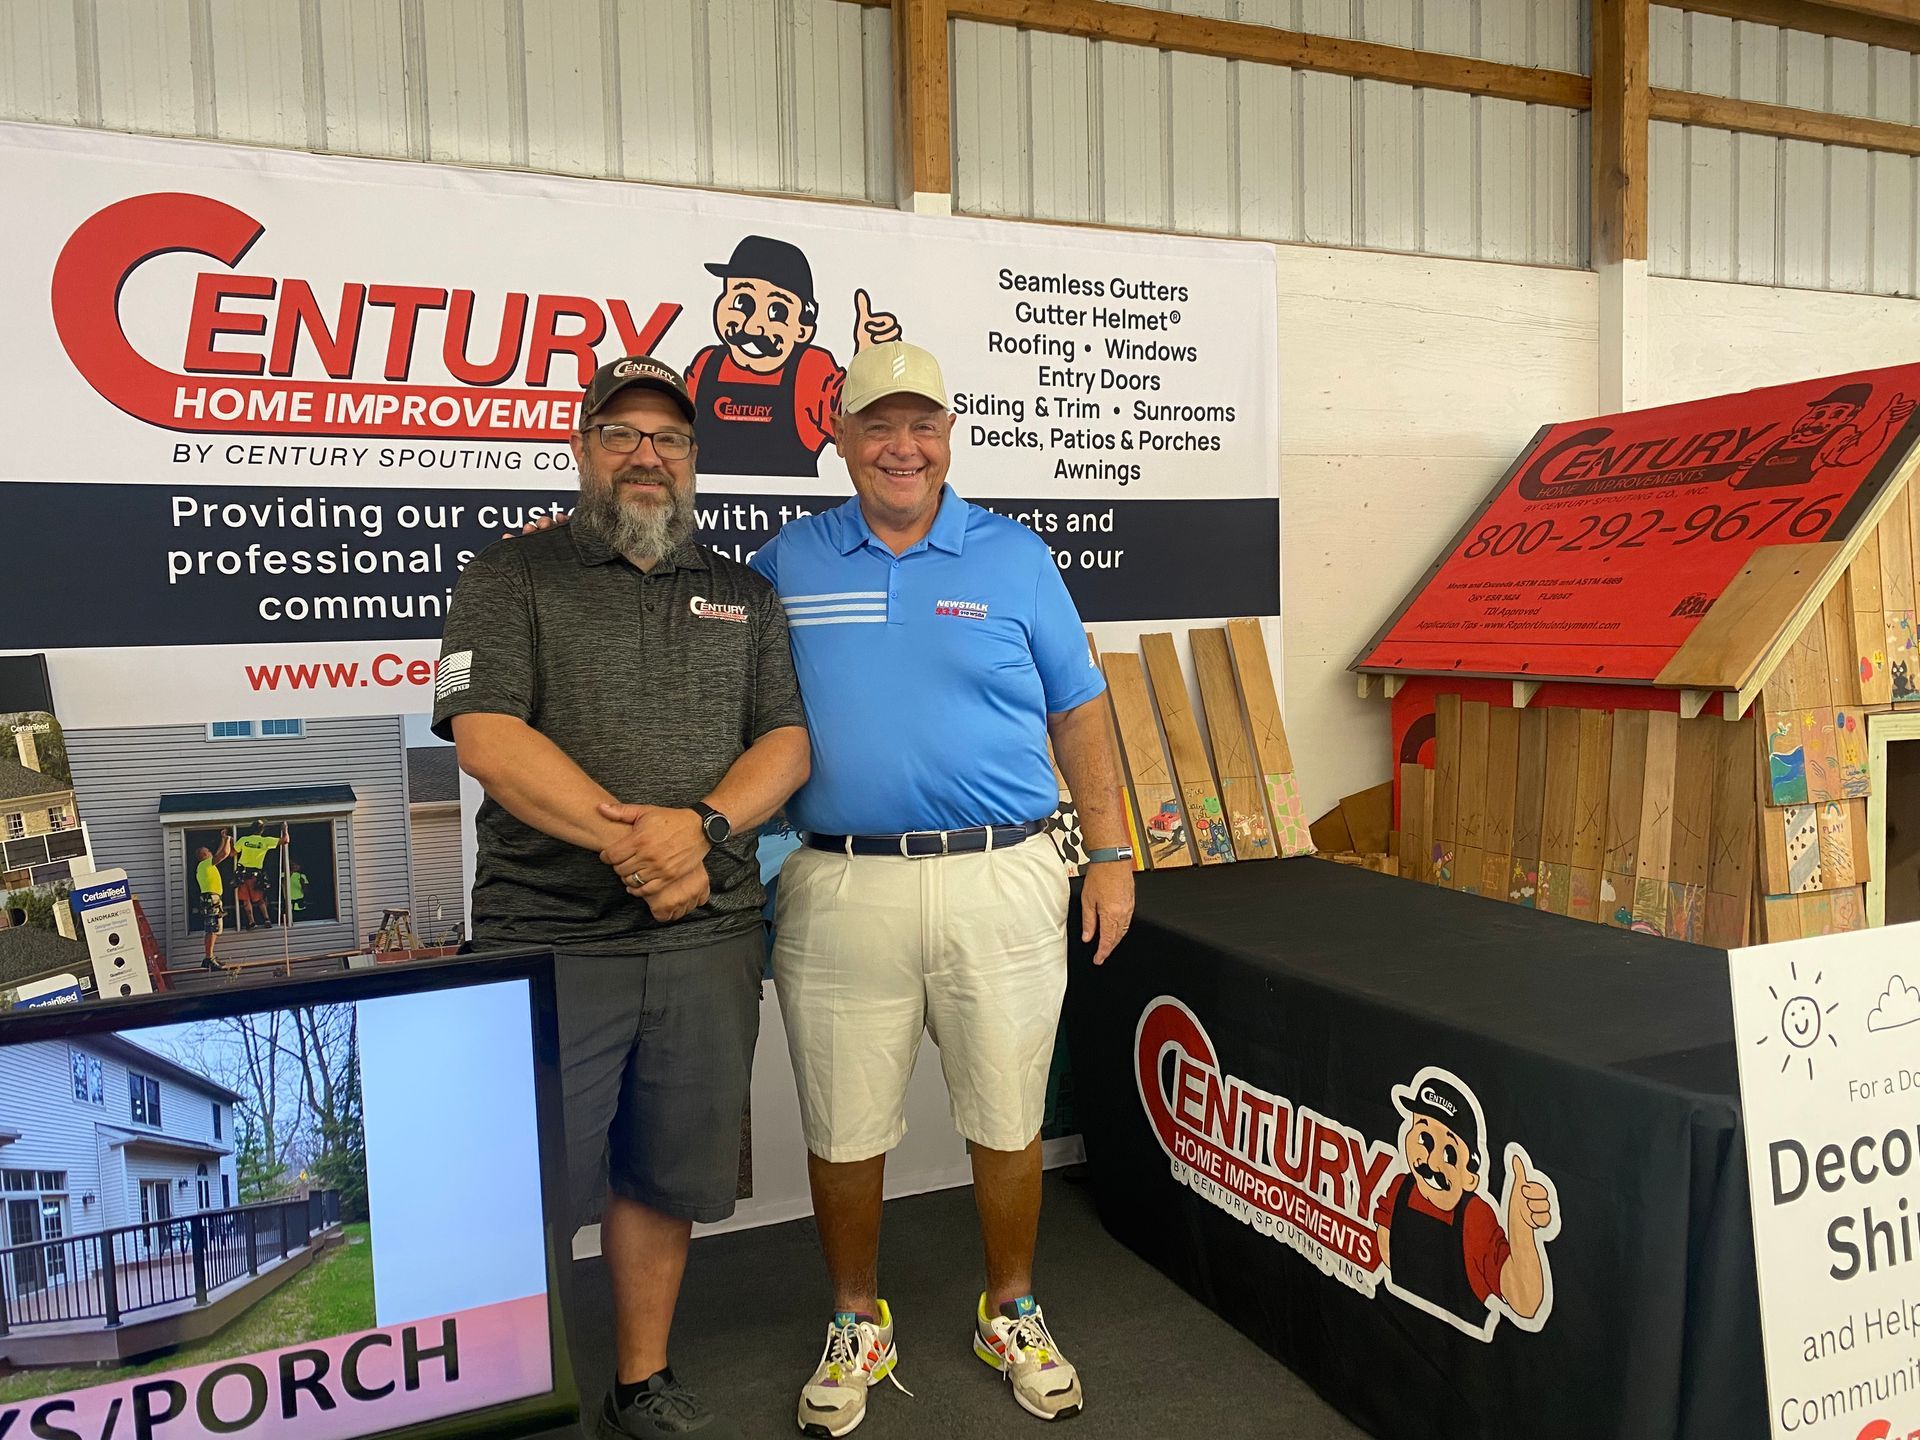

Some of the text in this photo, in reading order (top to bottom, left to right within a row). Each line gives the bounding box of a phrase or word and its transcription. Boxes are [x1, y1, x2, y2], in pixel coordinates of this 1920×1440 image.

[999, 268, 1189, 302] Seamless Gutters
[52, 192, 683, 436] CENTURY
[1015, 301, 1087, 326] Gutter
[989, 331, 1197, 362] Roofing Windows
[613, 361, 675, 381] CENTURY
[1038, 365, 1161, 394] Entry Doors
[173, 387, 312, 423] HOME
[714, 396, 773, 419] CENTURY
[953, 393, 1236, 422] Siding & Trim Sunrooms
[970, 425, 1221, 451] Decks, Patios & Porches
[173, 444, 577, 471] BY CENTURY SPOUTING CO.
[1518, 422, 1781, 499] CENTURY
[1054, 459, 1141, 486] Awnings
[1536, 469, 1708, 498] HOME IMPROVEMENTS
[172, 496, 383, 537] Providing
[397, 503, 465, 530] our
[477, 502, 576, 529] cust
[693, 503, 769, 531] with
[1066, 508, 1114, 533] and
[1540, 499, 1593, 511] CENTURY
[1592, 493, 1656, 505] SPOUTING
[1463, 492, 1843, 559] 800-292-9676
[167, 543, 443, 583] professional
[1080, 550, 1124, 569] our
[690, 596, 745, 615] CENTURY
[937, 600, 988, 611] NEWSTALK
[1499, 607, 1542, 617] Approved
[1416, 620, 1461, 630] Application
[10, 722, 50, 733] CertainTeed
[82, 885, 126, 902] CertainTeed
[1421, 1087, 1458, 1114] CENTURY
[1848, 1080, 1878, 1101] For
[1884, 1077, 1894, 1095] a
[1137, 1000, 1394, 1221] CENTURY
[1768, 1124, 1920, 1206] Deco
[1174, 1131, 1372, 1263] HOME IMPROVEMENTS
[1173, 1161, 1370, 1288] BY CENTURY SPOUTING, INC.
[1826, 1197, 1920, 1281] Shi
[1802, 1315, 1855, 1363] and
